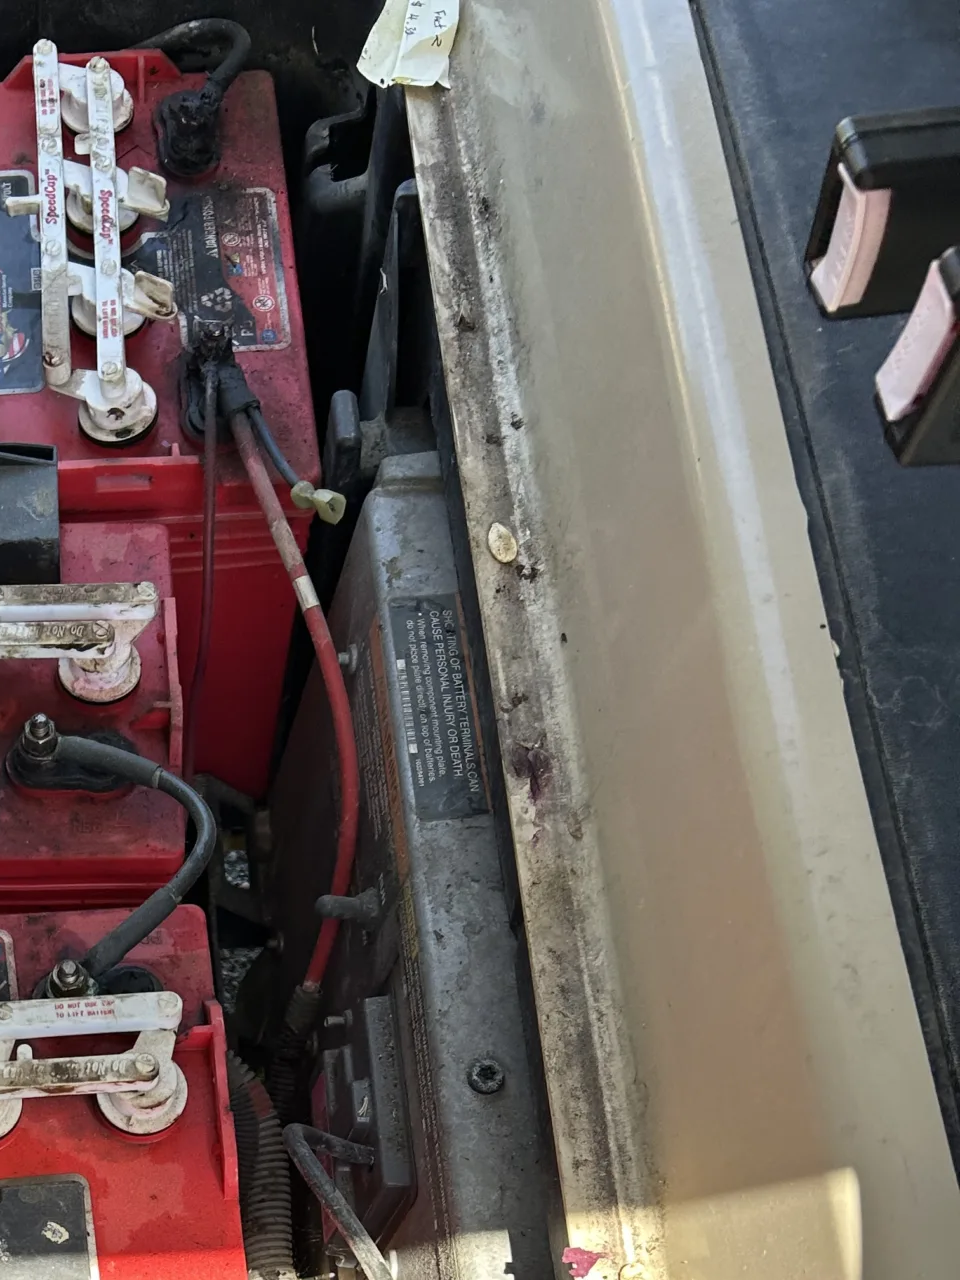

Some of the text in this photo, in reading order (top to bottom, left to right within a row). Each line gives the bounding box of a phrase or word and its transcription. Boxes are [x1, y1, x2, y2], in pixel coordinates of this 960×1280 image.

[406, 619, 414, 628] do
[416, 618, 426, 639] When
[429, 610, 441, 640] CAUSE
[407, 631, 416, 643] not
[418, 641, 431, 675] removing
[434, 642, 449, 692] PERSONAL
[449, 658, 460, 671] OF
[424, 676, 438, 717] component
[451, 673, 466, 713] BATTERY
[419, 714, 428, 724] on
[442, 694, 455, 726] INJURY
[423, 739, 432, 748] of
[430, 719, 443, 755] mounting
[448, 728, 458, 743] OR
[459, 717, 475, 770] TERMINALS
[466, 771, 479, 791] CAN
